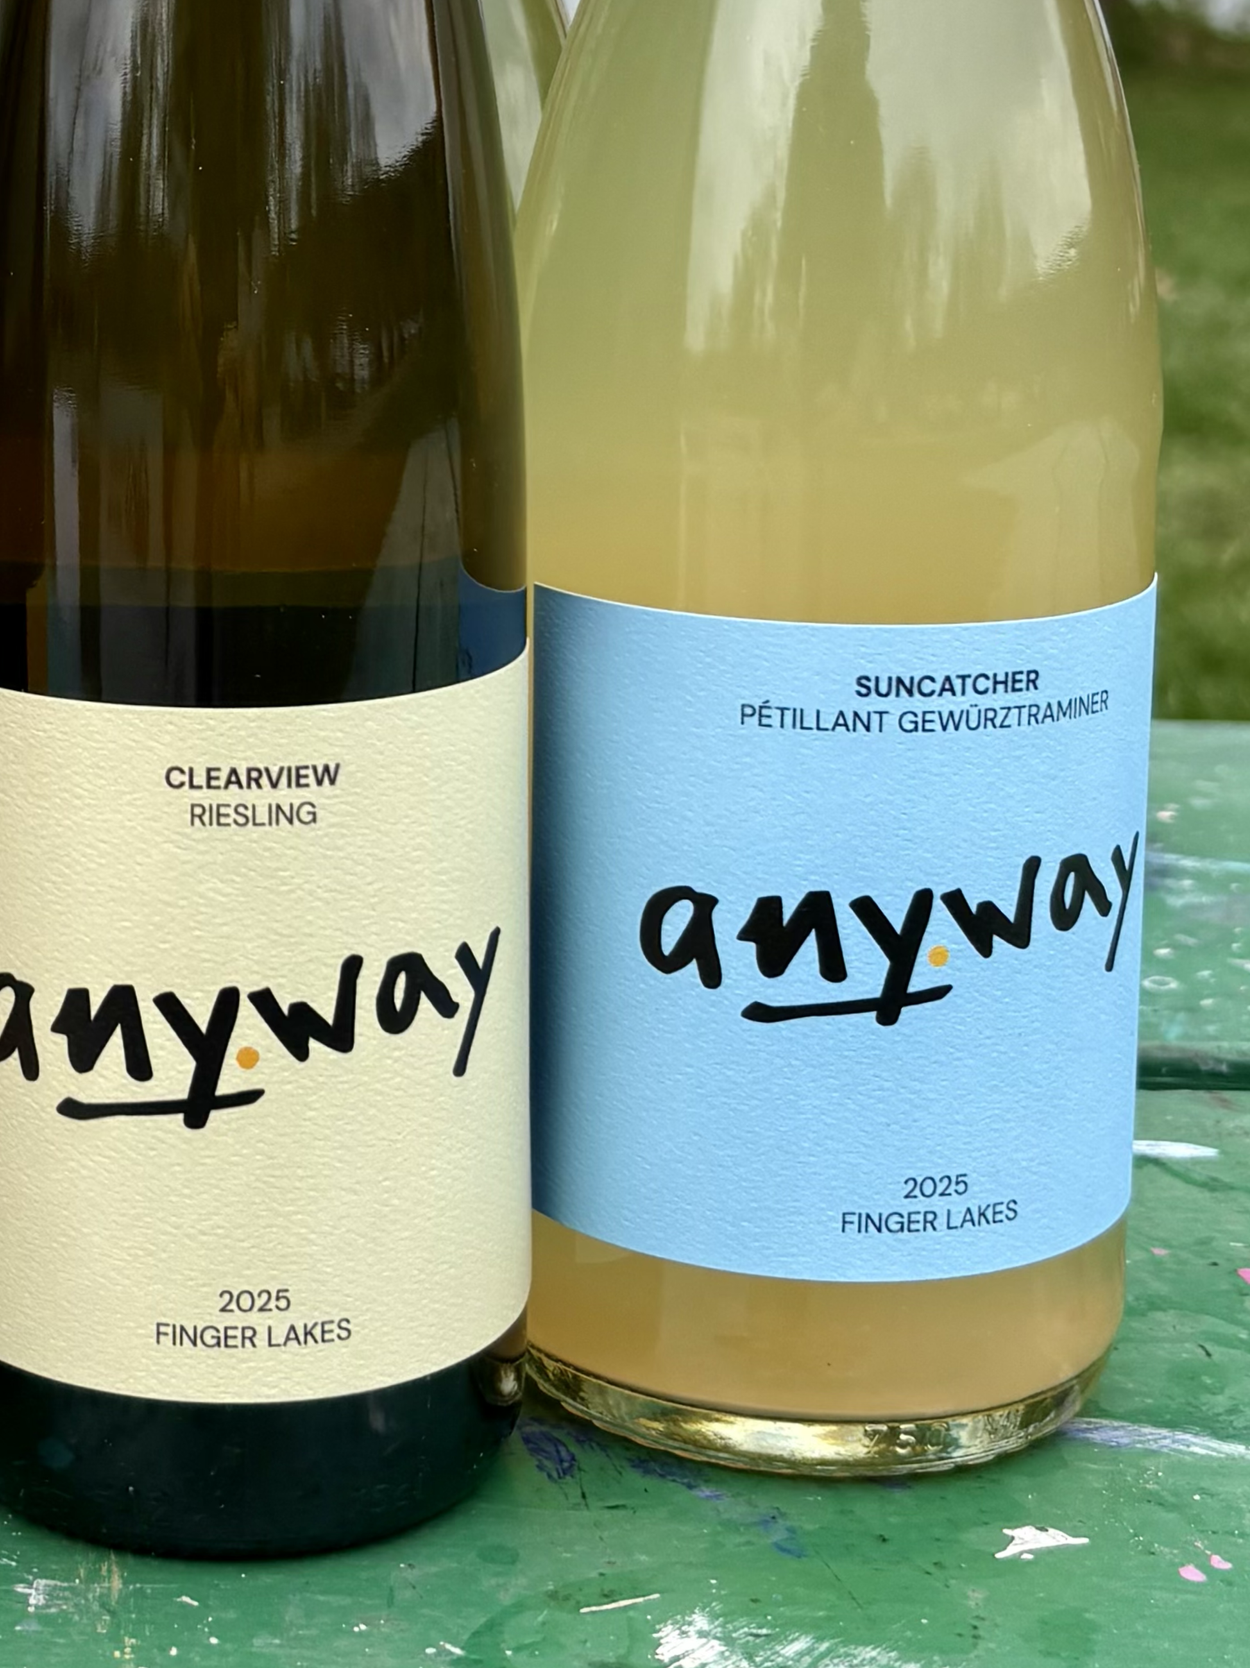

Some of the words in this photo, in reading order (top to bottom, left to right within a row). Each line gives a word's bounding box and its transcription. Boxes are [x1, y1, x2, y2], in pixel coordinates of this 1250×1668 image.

[855, 669, 1040, 698] SUNCATCHER
[740, 699, 890, 733] PÉTILLANT
[897, 689, 1109, 733] GEWÜRZTRAMINER
[164, 762, 341, 790] CLEARVIEW
[190, 801, 317, 827] RIESLING
[903, 1173, 969, 1199] 2025
[841, 1210, 938, 1234] FINGER
[945, 1199, 1018, 1230] LAKES
[218, 1288, 291, 1313] 2025
[156, 1322, 258, 1349] FINGER
[267, 1317, 352, 1348] LAKES
